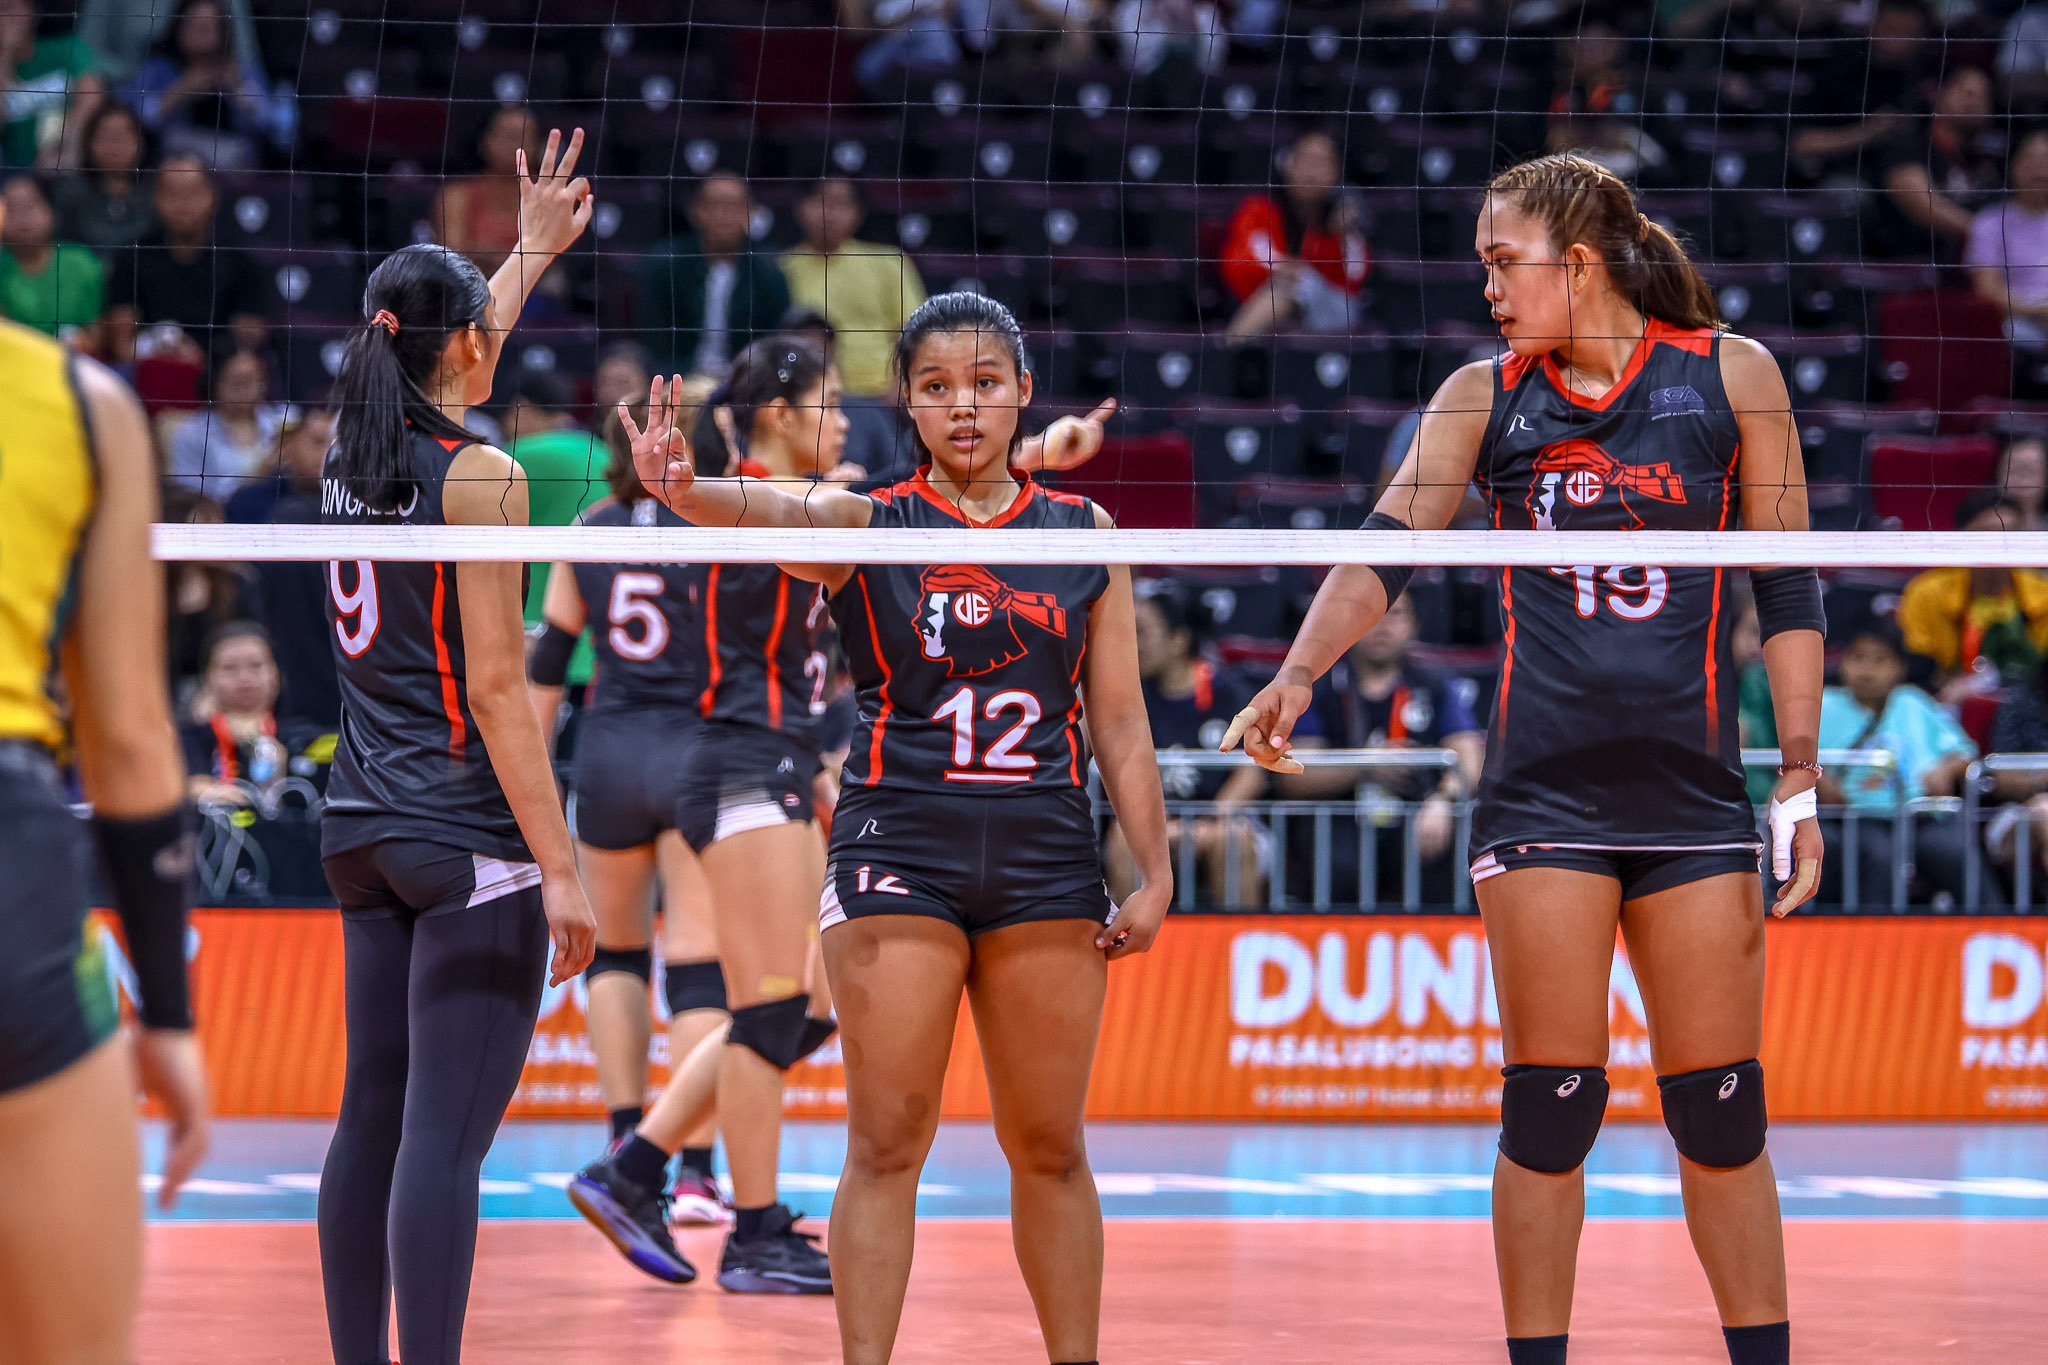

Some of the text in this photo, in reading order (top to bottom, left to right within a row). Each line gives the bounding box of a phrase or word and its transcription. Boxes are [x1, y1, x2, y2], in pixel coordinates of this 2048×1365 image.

[328, 560, 381, 659] 9
[608, 571, 671, 661] 5
[953, 592, 993, 628] UE
[1548, 565, 1670, 621] 19
[931, 685, 1042, 770] 12
